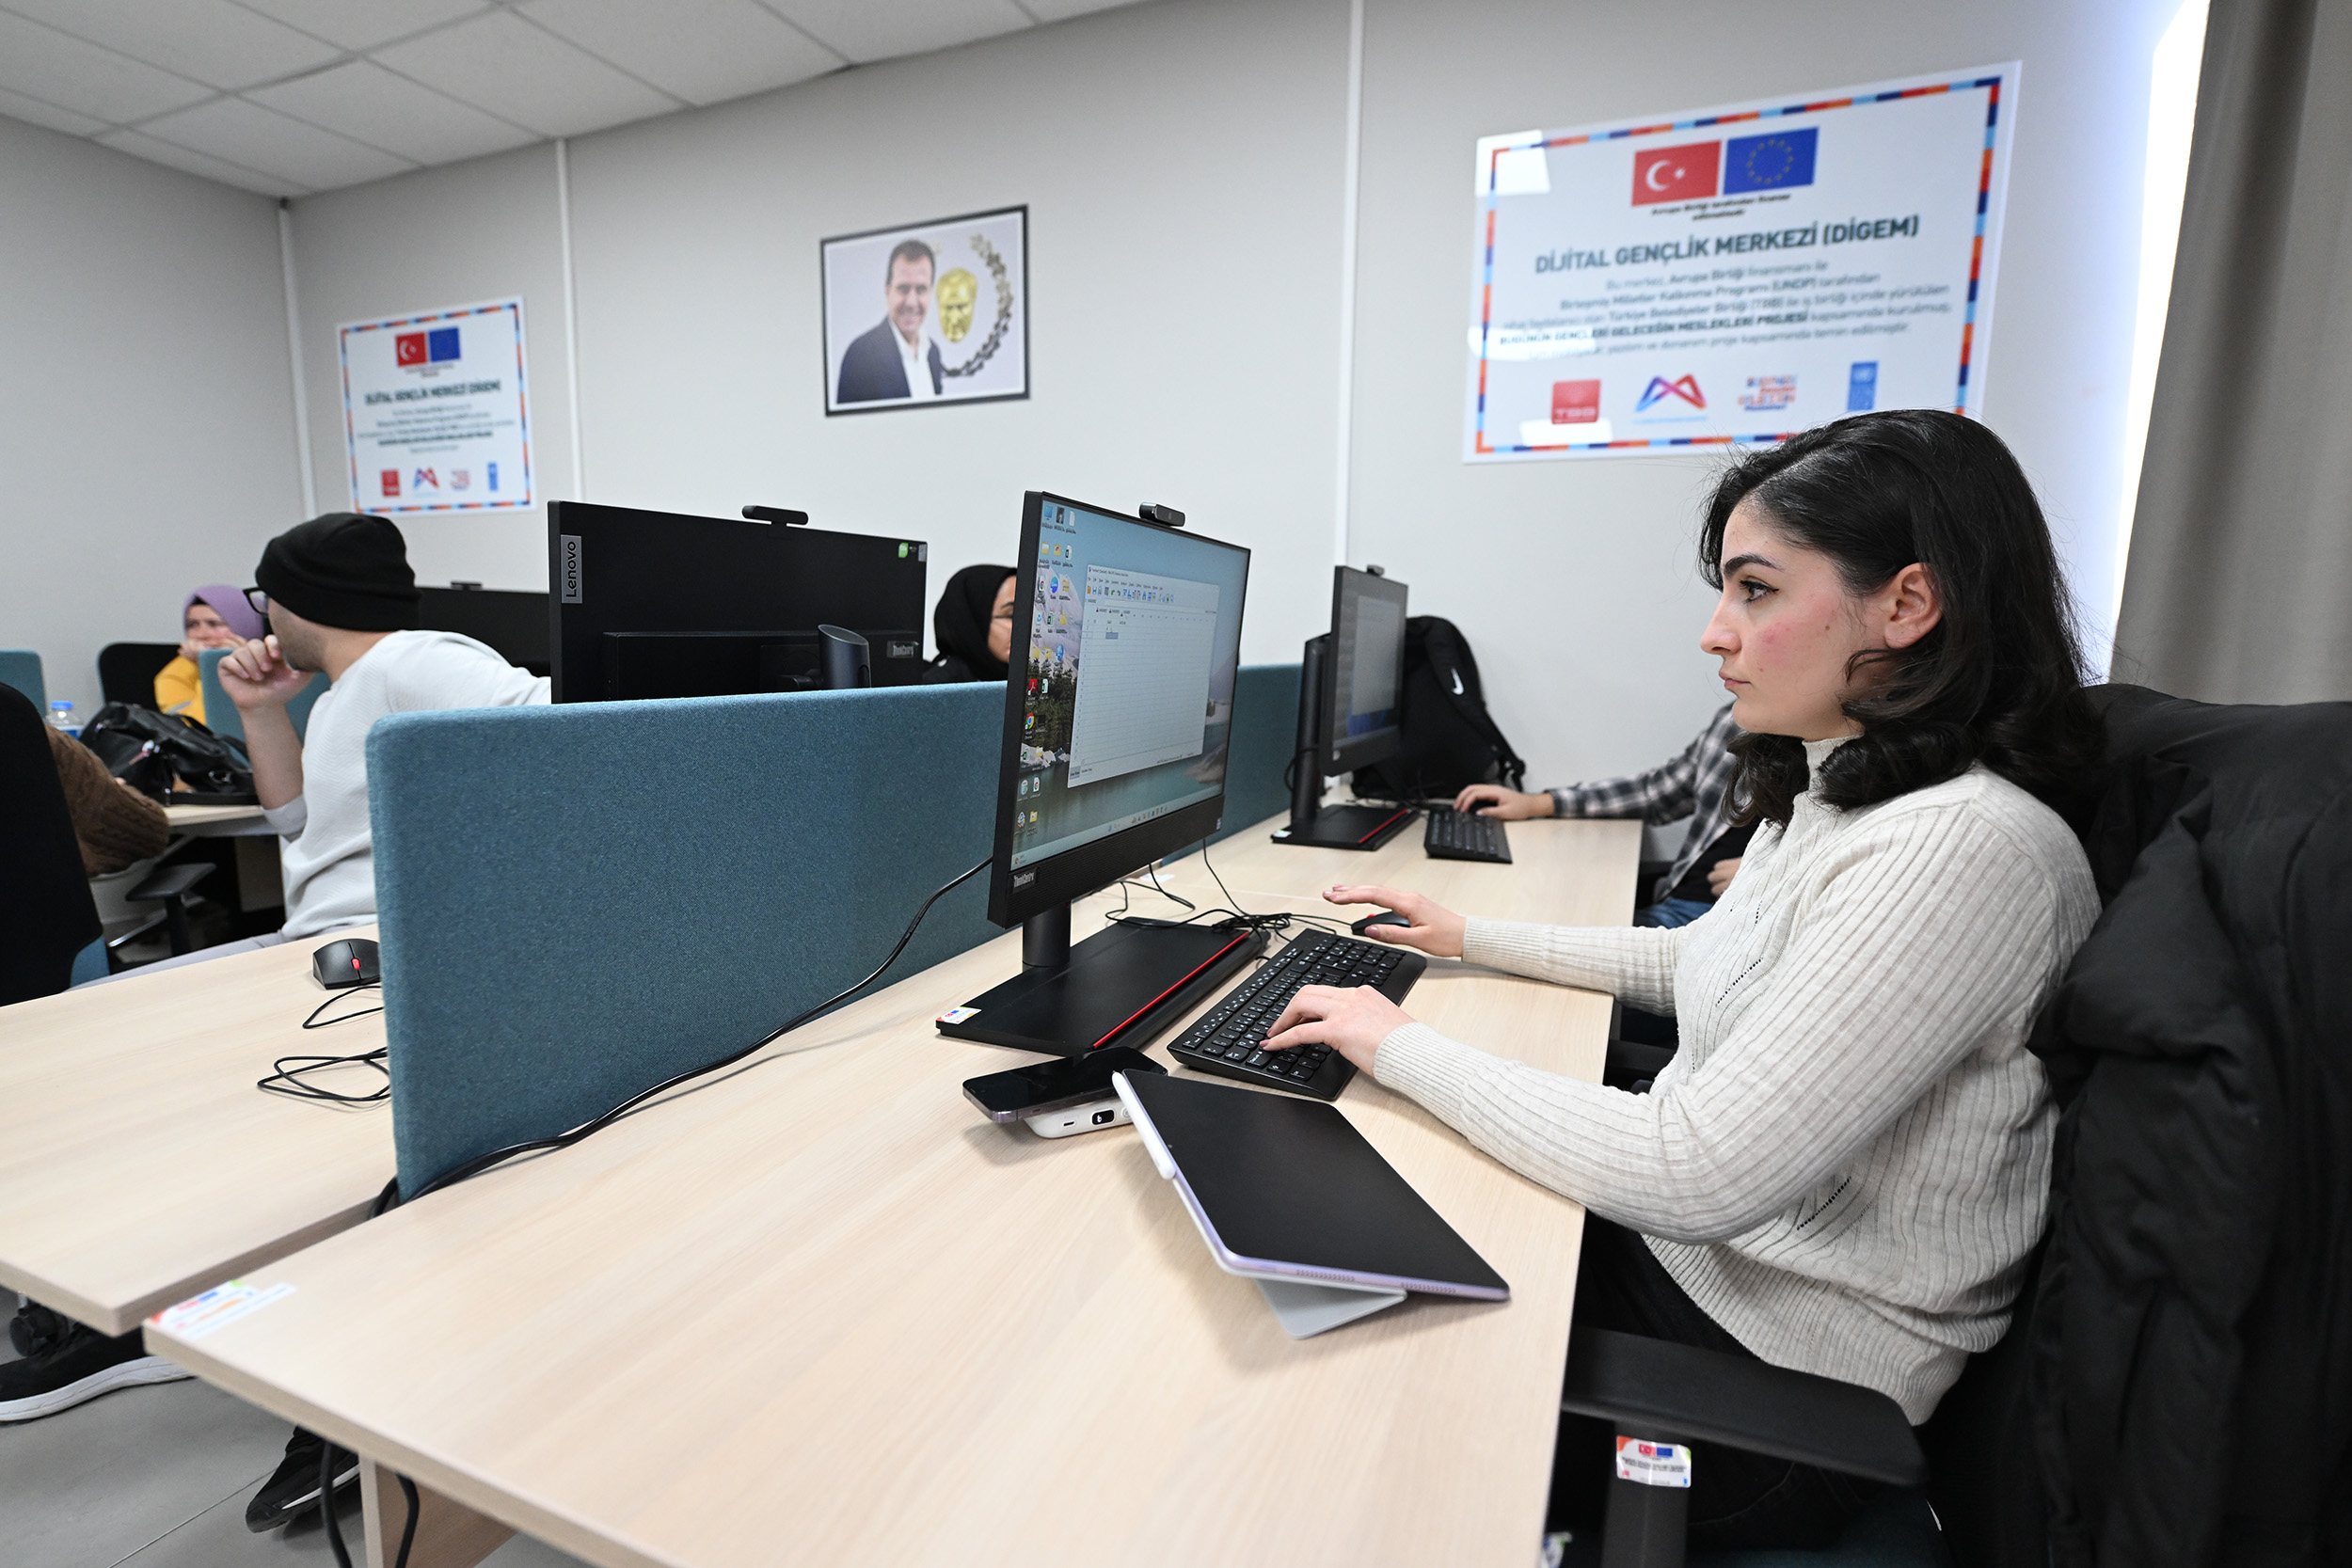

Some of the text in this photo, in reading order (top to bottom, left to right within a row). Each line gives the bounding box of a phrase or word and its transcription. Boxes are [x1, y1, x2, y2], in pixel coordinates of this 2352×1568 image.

[1535, 214, 1920, 274] DİJİTAL GENÇLİK MERKEZİ (DİGEM)
[565, 541, 577, 598] Lenovo
